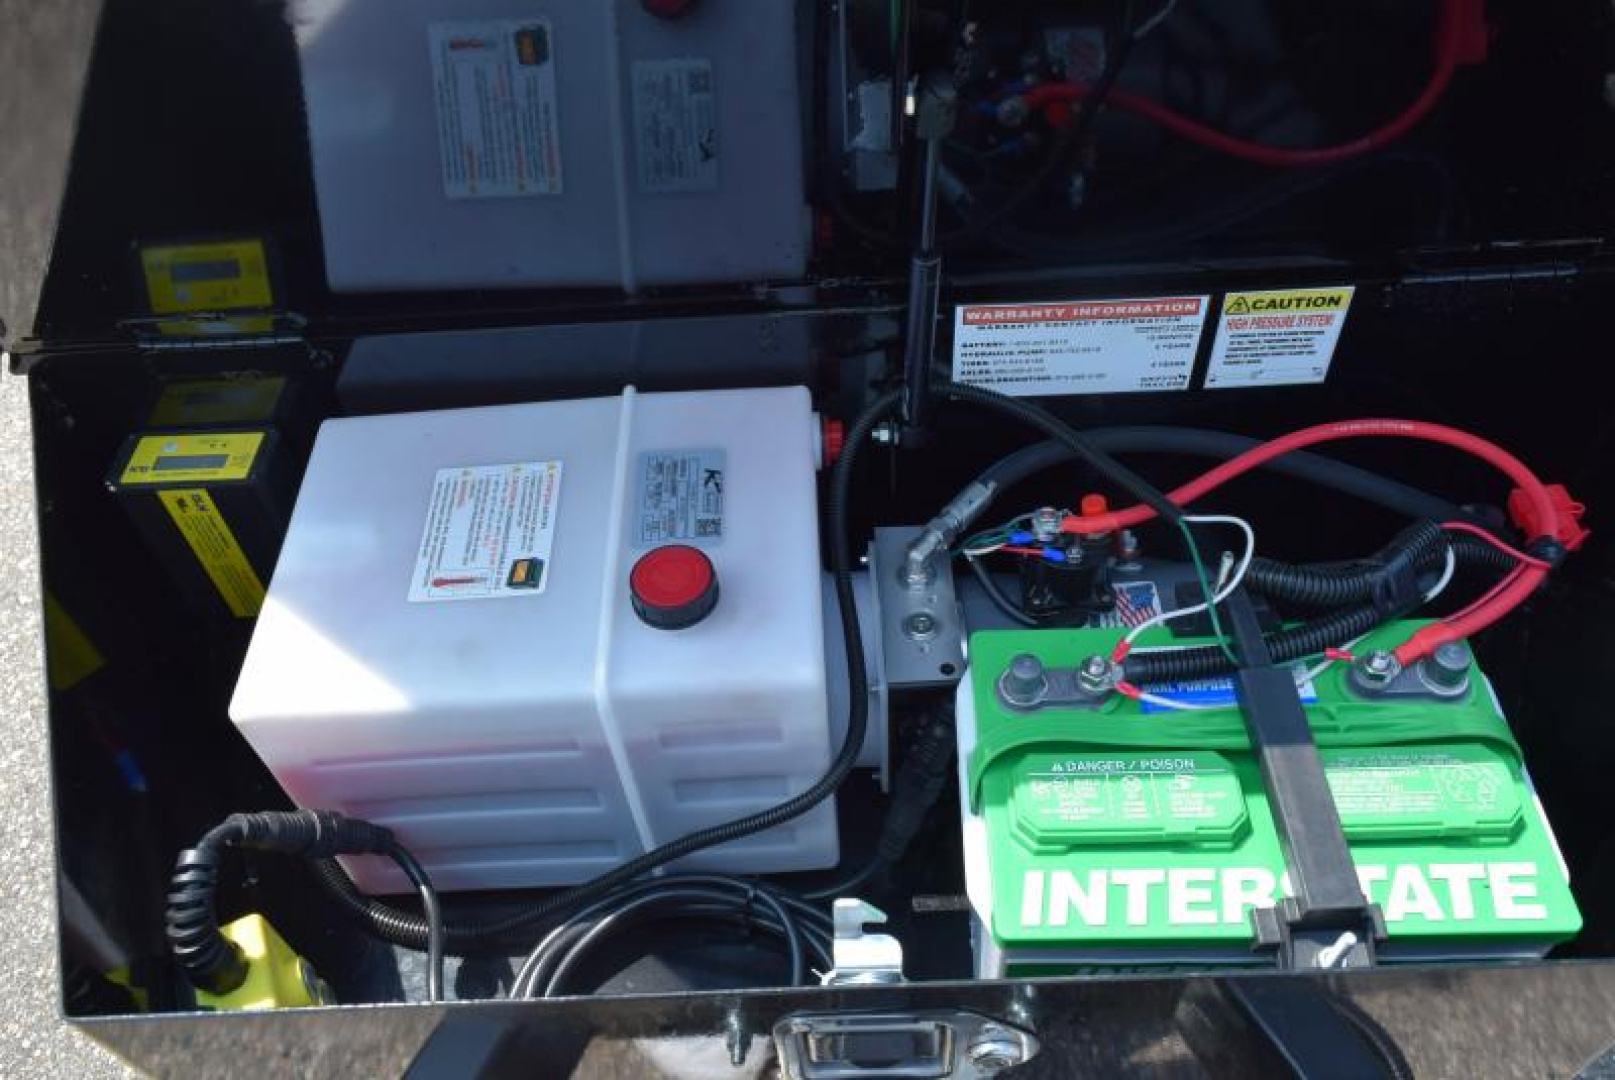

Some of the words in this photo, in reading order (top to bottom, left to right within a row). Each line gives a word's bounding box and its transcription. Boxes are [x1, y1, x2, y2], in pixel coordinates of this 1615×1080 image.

[966, 308, 1066, 320] WARRANTY
[1073, 302, 1196, 316] INFORMATION
[1251, 296, 1342, 310] CAUTION
[1065, 760, 1126, 772] DANGER
[1140, 758, 1195, 770] POISON
[1019, 862, 1548, 927] INTERATE
